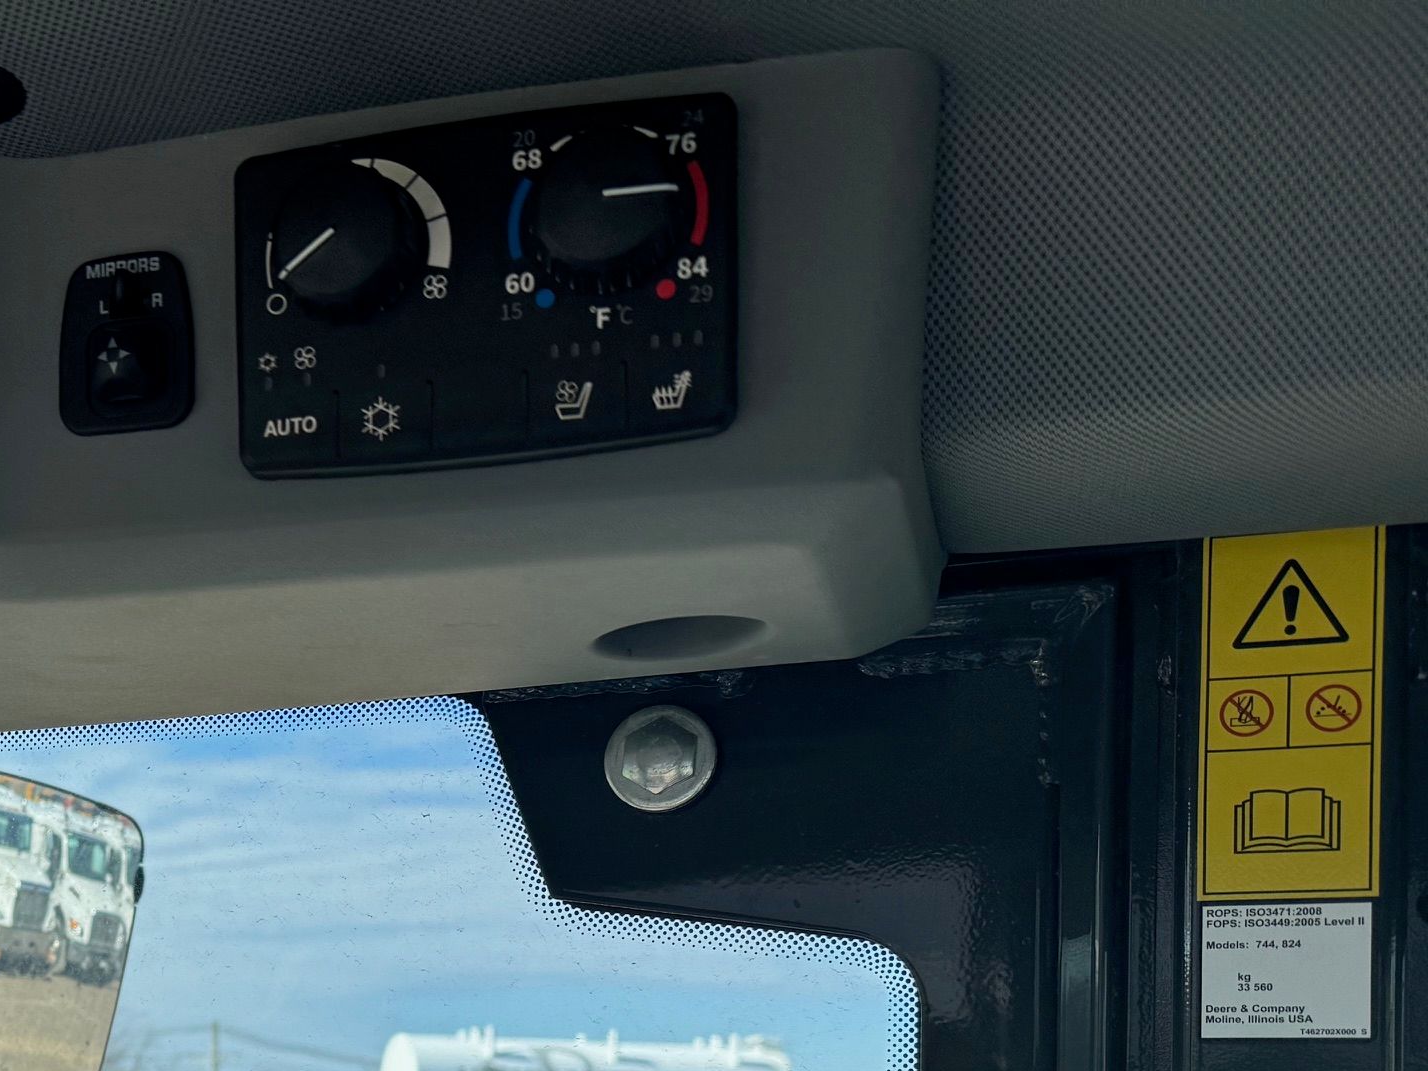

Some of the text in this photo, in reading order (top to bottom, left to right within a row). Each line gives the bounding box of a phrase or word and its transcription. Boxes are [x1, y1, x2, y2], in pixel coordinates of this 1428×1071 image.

[512, 130, 536, 148] 20
[665, 132, 697, 156] 76
[512, 149, 542, 171] 68
[677, 256, 709, 280] 84
[505, 272, 535, 295] 60
[151, 292, 164, 308] R
[688, 285, 713, 303] 29
[98, 299, 109, 315] L
[500, 304, 523, 321] 15
[263, 415, 317, 438] AUTO
[1206, 906, 1322, 918] ROPS: ISO3471:2008
[1206, 918, 1241, 929] FOPS:
[1244, 917, 1321, 928] ISO3449:2005
[1324, 917, 1355, 927] Level
[1206, 940, 1301, 950] Models: 744, 824
[1237, 972, 1251, 983] kg
[1237, 983, 1273, 992] 33 560
[1205, 1004, 1305, 1015] Deere & Company
[1205, 1015, 1313, 1025] Moline, Illinois USA
